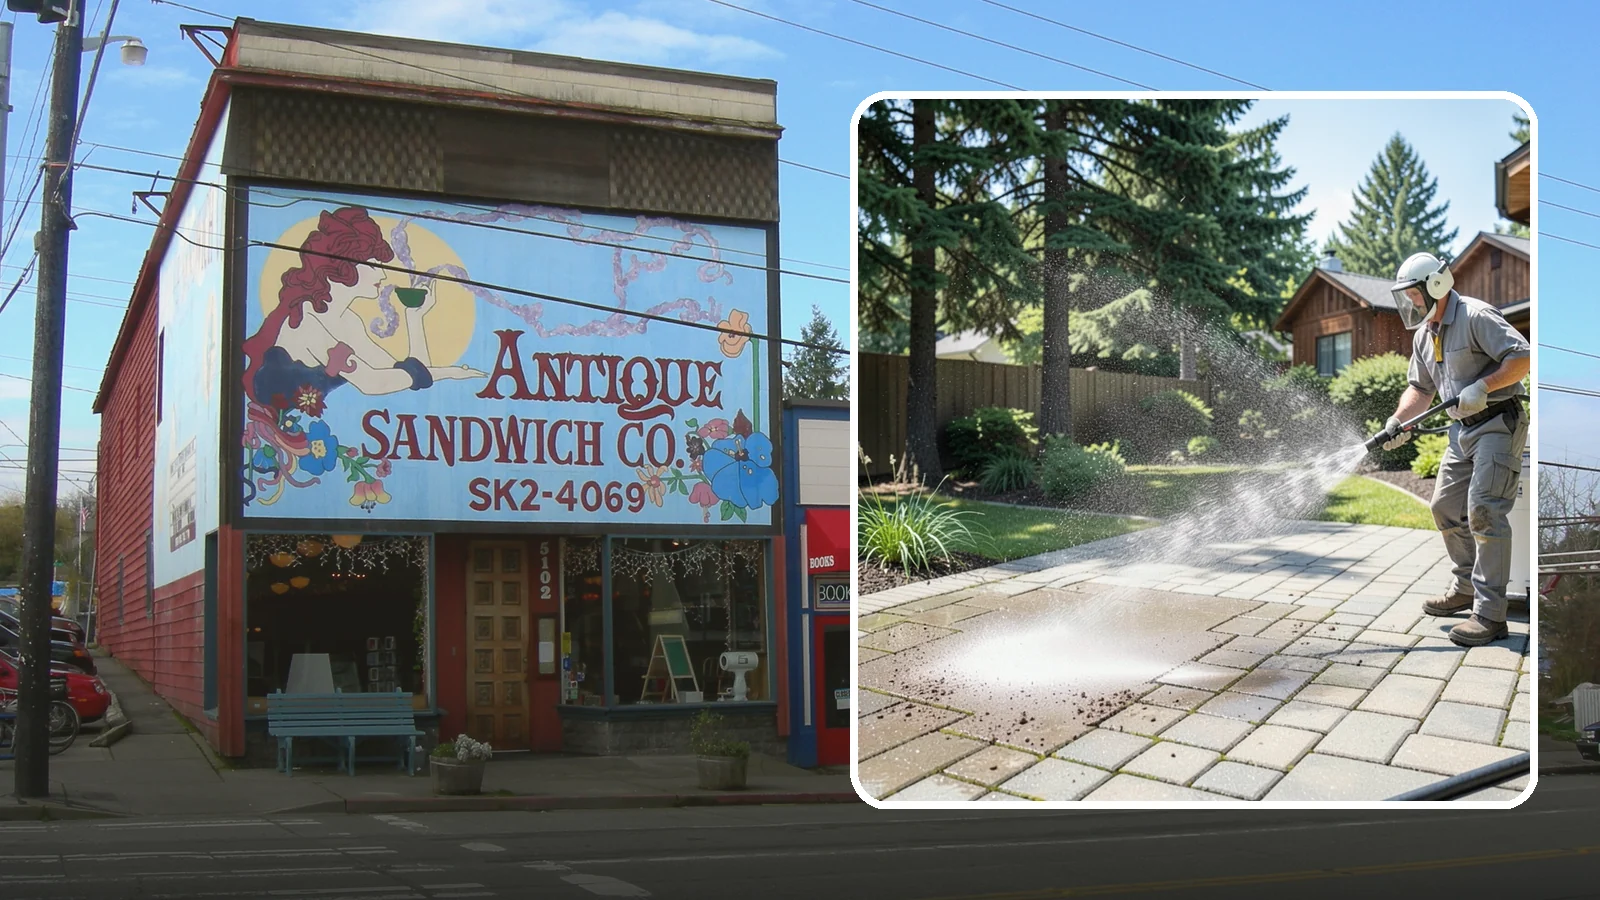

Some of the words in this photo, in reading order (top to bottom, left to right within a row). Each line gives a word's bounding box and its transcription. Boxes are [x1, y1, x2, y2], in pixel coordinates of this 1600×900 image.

[476, 330, 723, 421] ANTIQUE
[361, 408, 604, 467] SANDWICH
[617, 421, 684, 468] CO.
[468, 478, 645, 513] SK2-4069
[539, 542, 551, 600] 5102
[809, 555, 835, 569] BOOKS
